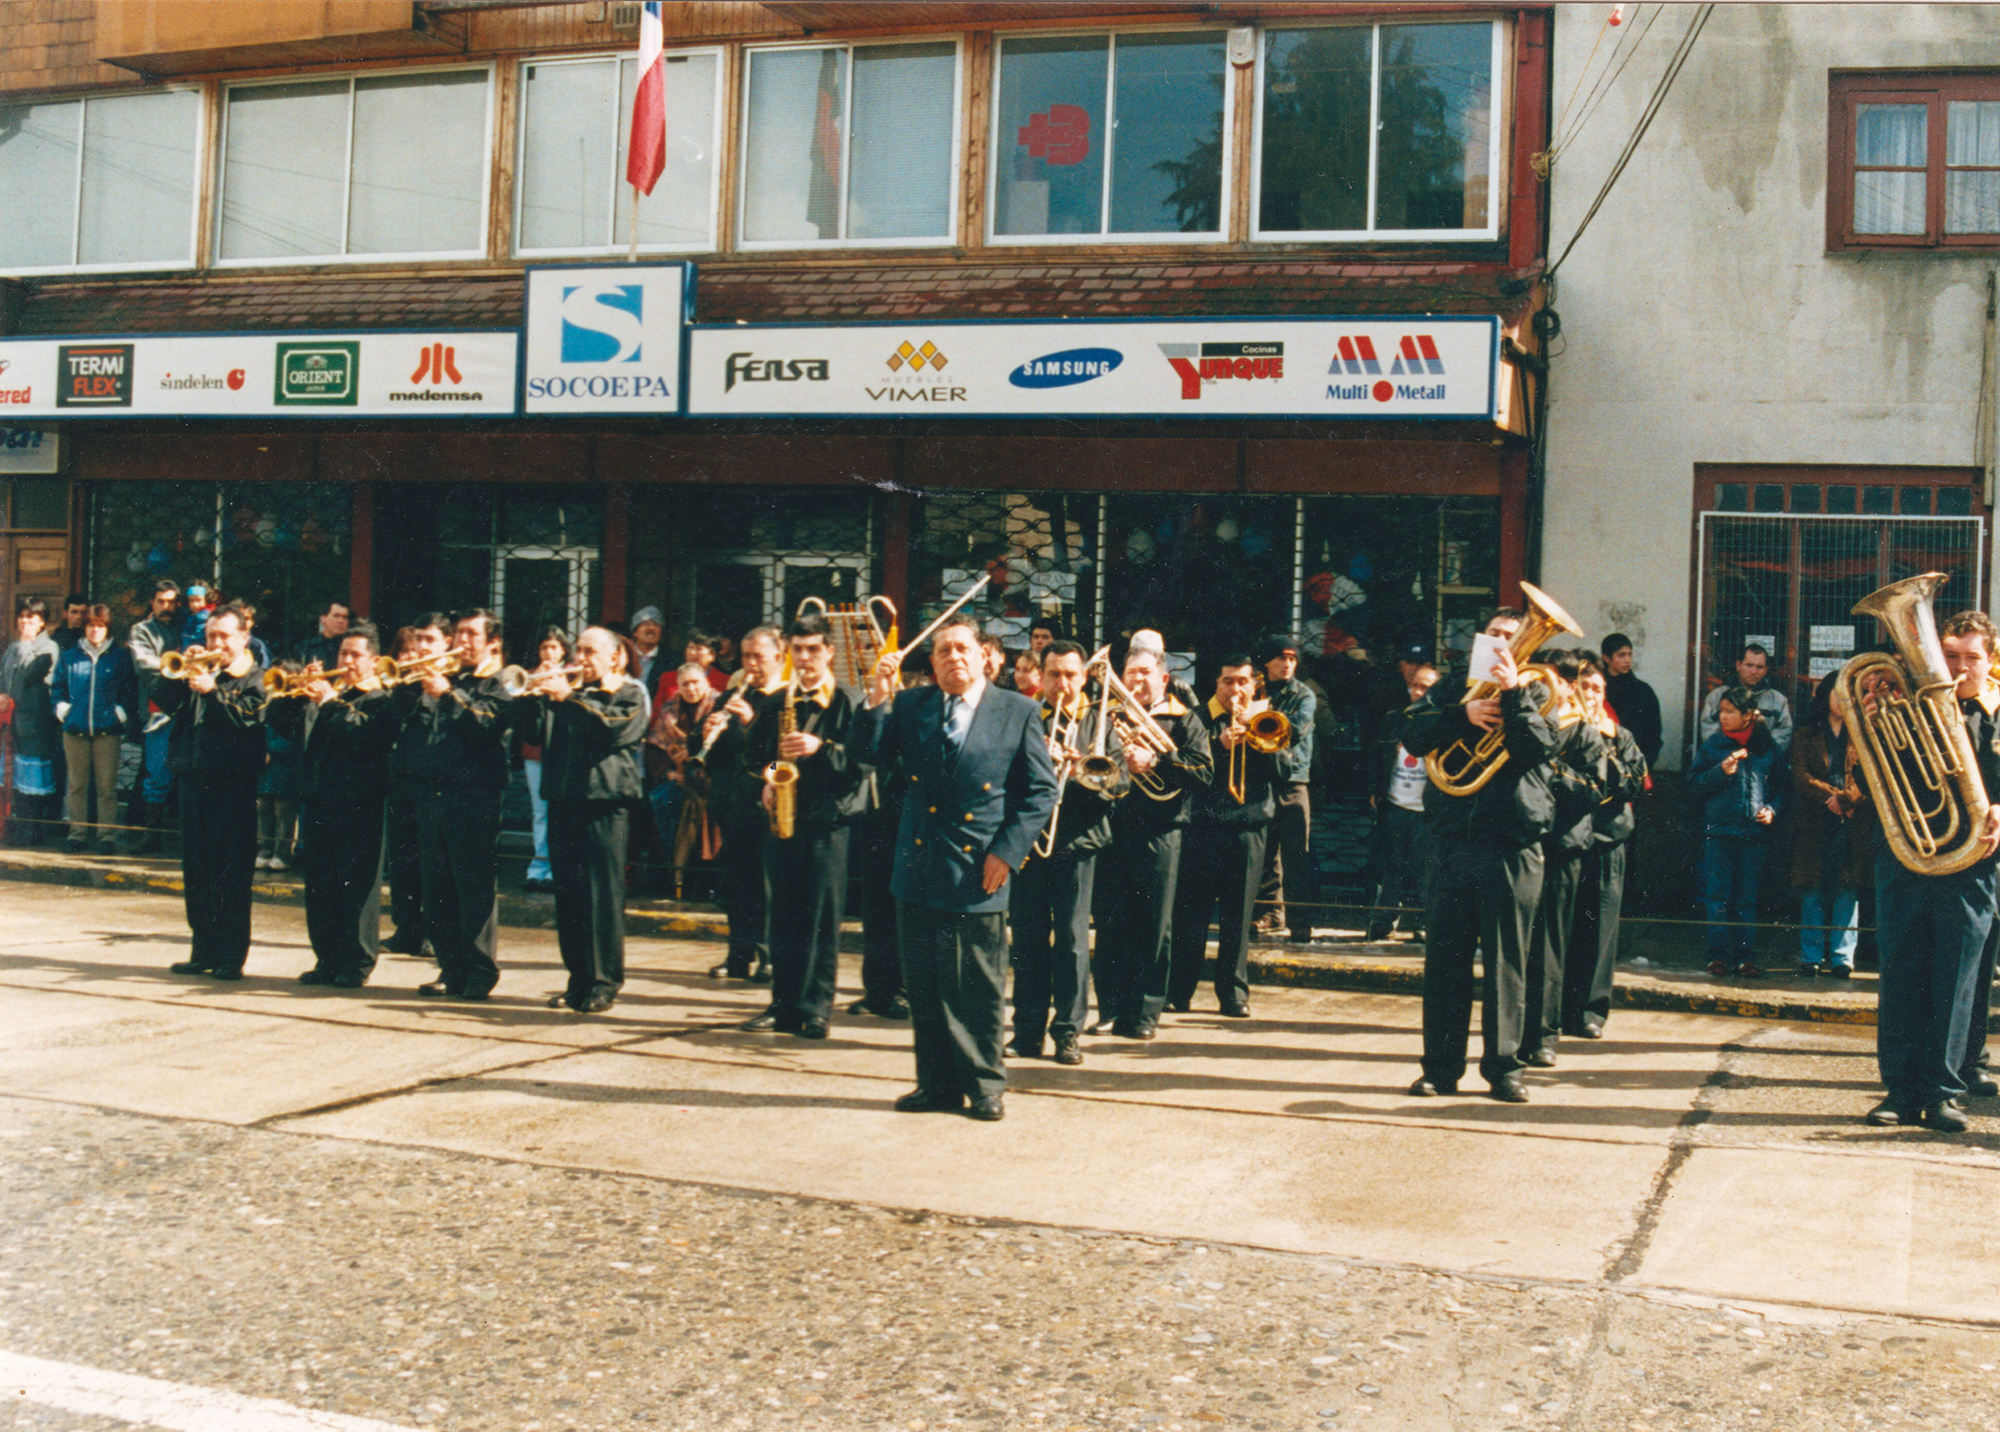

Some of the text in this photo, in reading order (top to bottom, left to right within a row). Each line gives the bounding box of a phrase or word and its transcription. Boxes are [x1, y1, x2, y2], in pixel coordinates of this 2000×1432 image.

[1241, 345, 1278, 354] Cocinas
[68, 356, 124, 376] TERMI
[1022, 361, 1110, 377] SAMSUNG
[160, 372, 224, 390] sindelen
[289, 370, 343, 385] ORIENT
[73, 377, 116, 396] FLEX
[528, 376, 671, 398] SOCOEPA
[864, 387, 968, 402] VIMER
[1326, 384, 1446, 400] Multi Metall
[389, 390, 483, 402] mademsa
